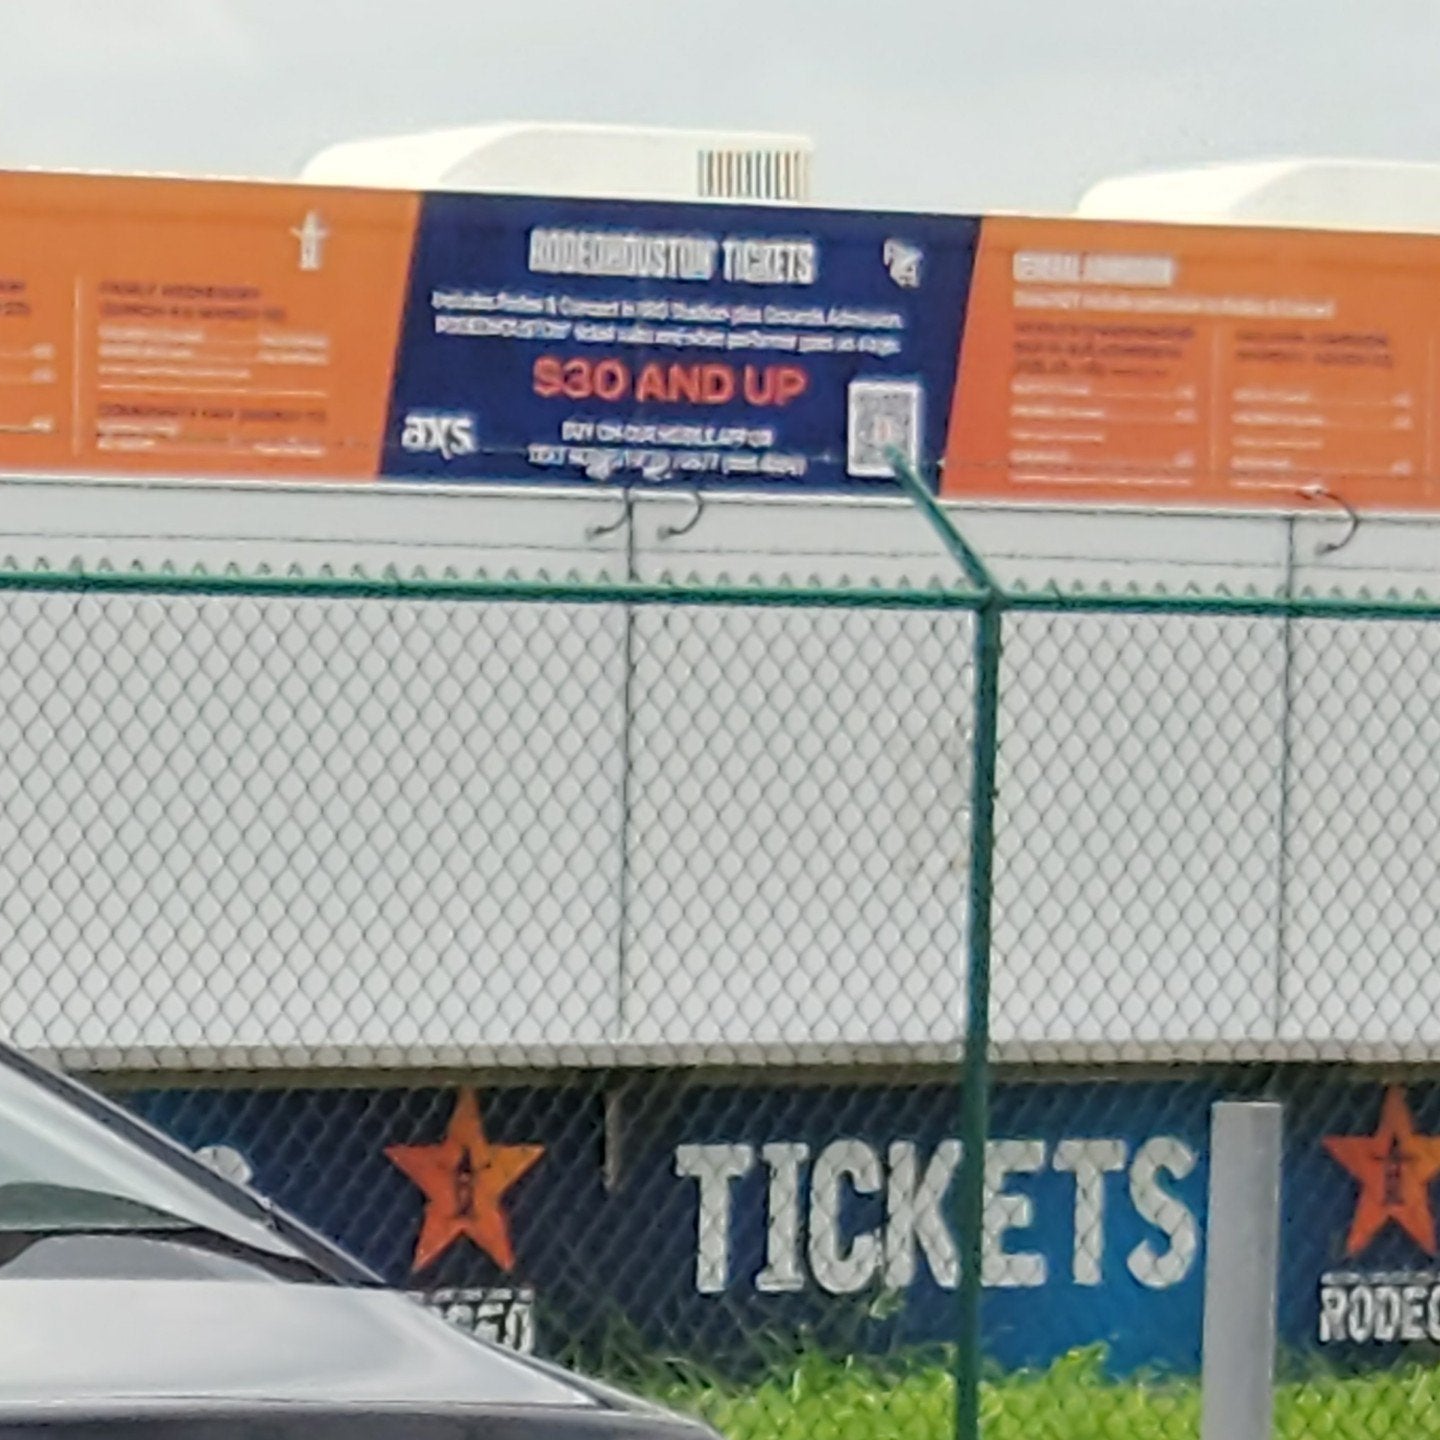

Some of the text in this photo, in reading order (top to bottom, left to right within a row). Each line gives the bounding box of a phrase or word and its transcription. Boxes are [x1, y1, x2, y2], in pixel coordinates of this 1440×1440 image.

[533, 355, 808, 407] $30 AND UP
[401, 414, 476, 460] axs
[676, 1136, 1201, 1294] TICKETS
